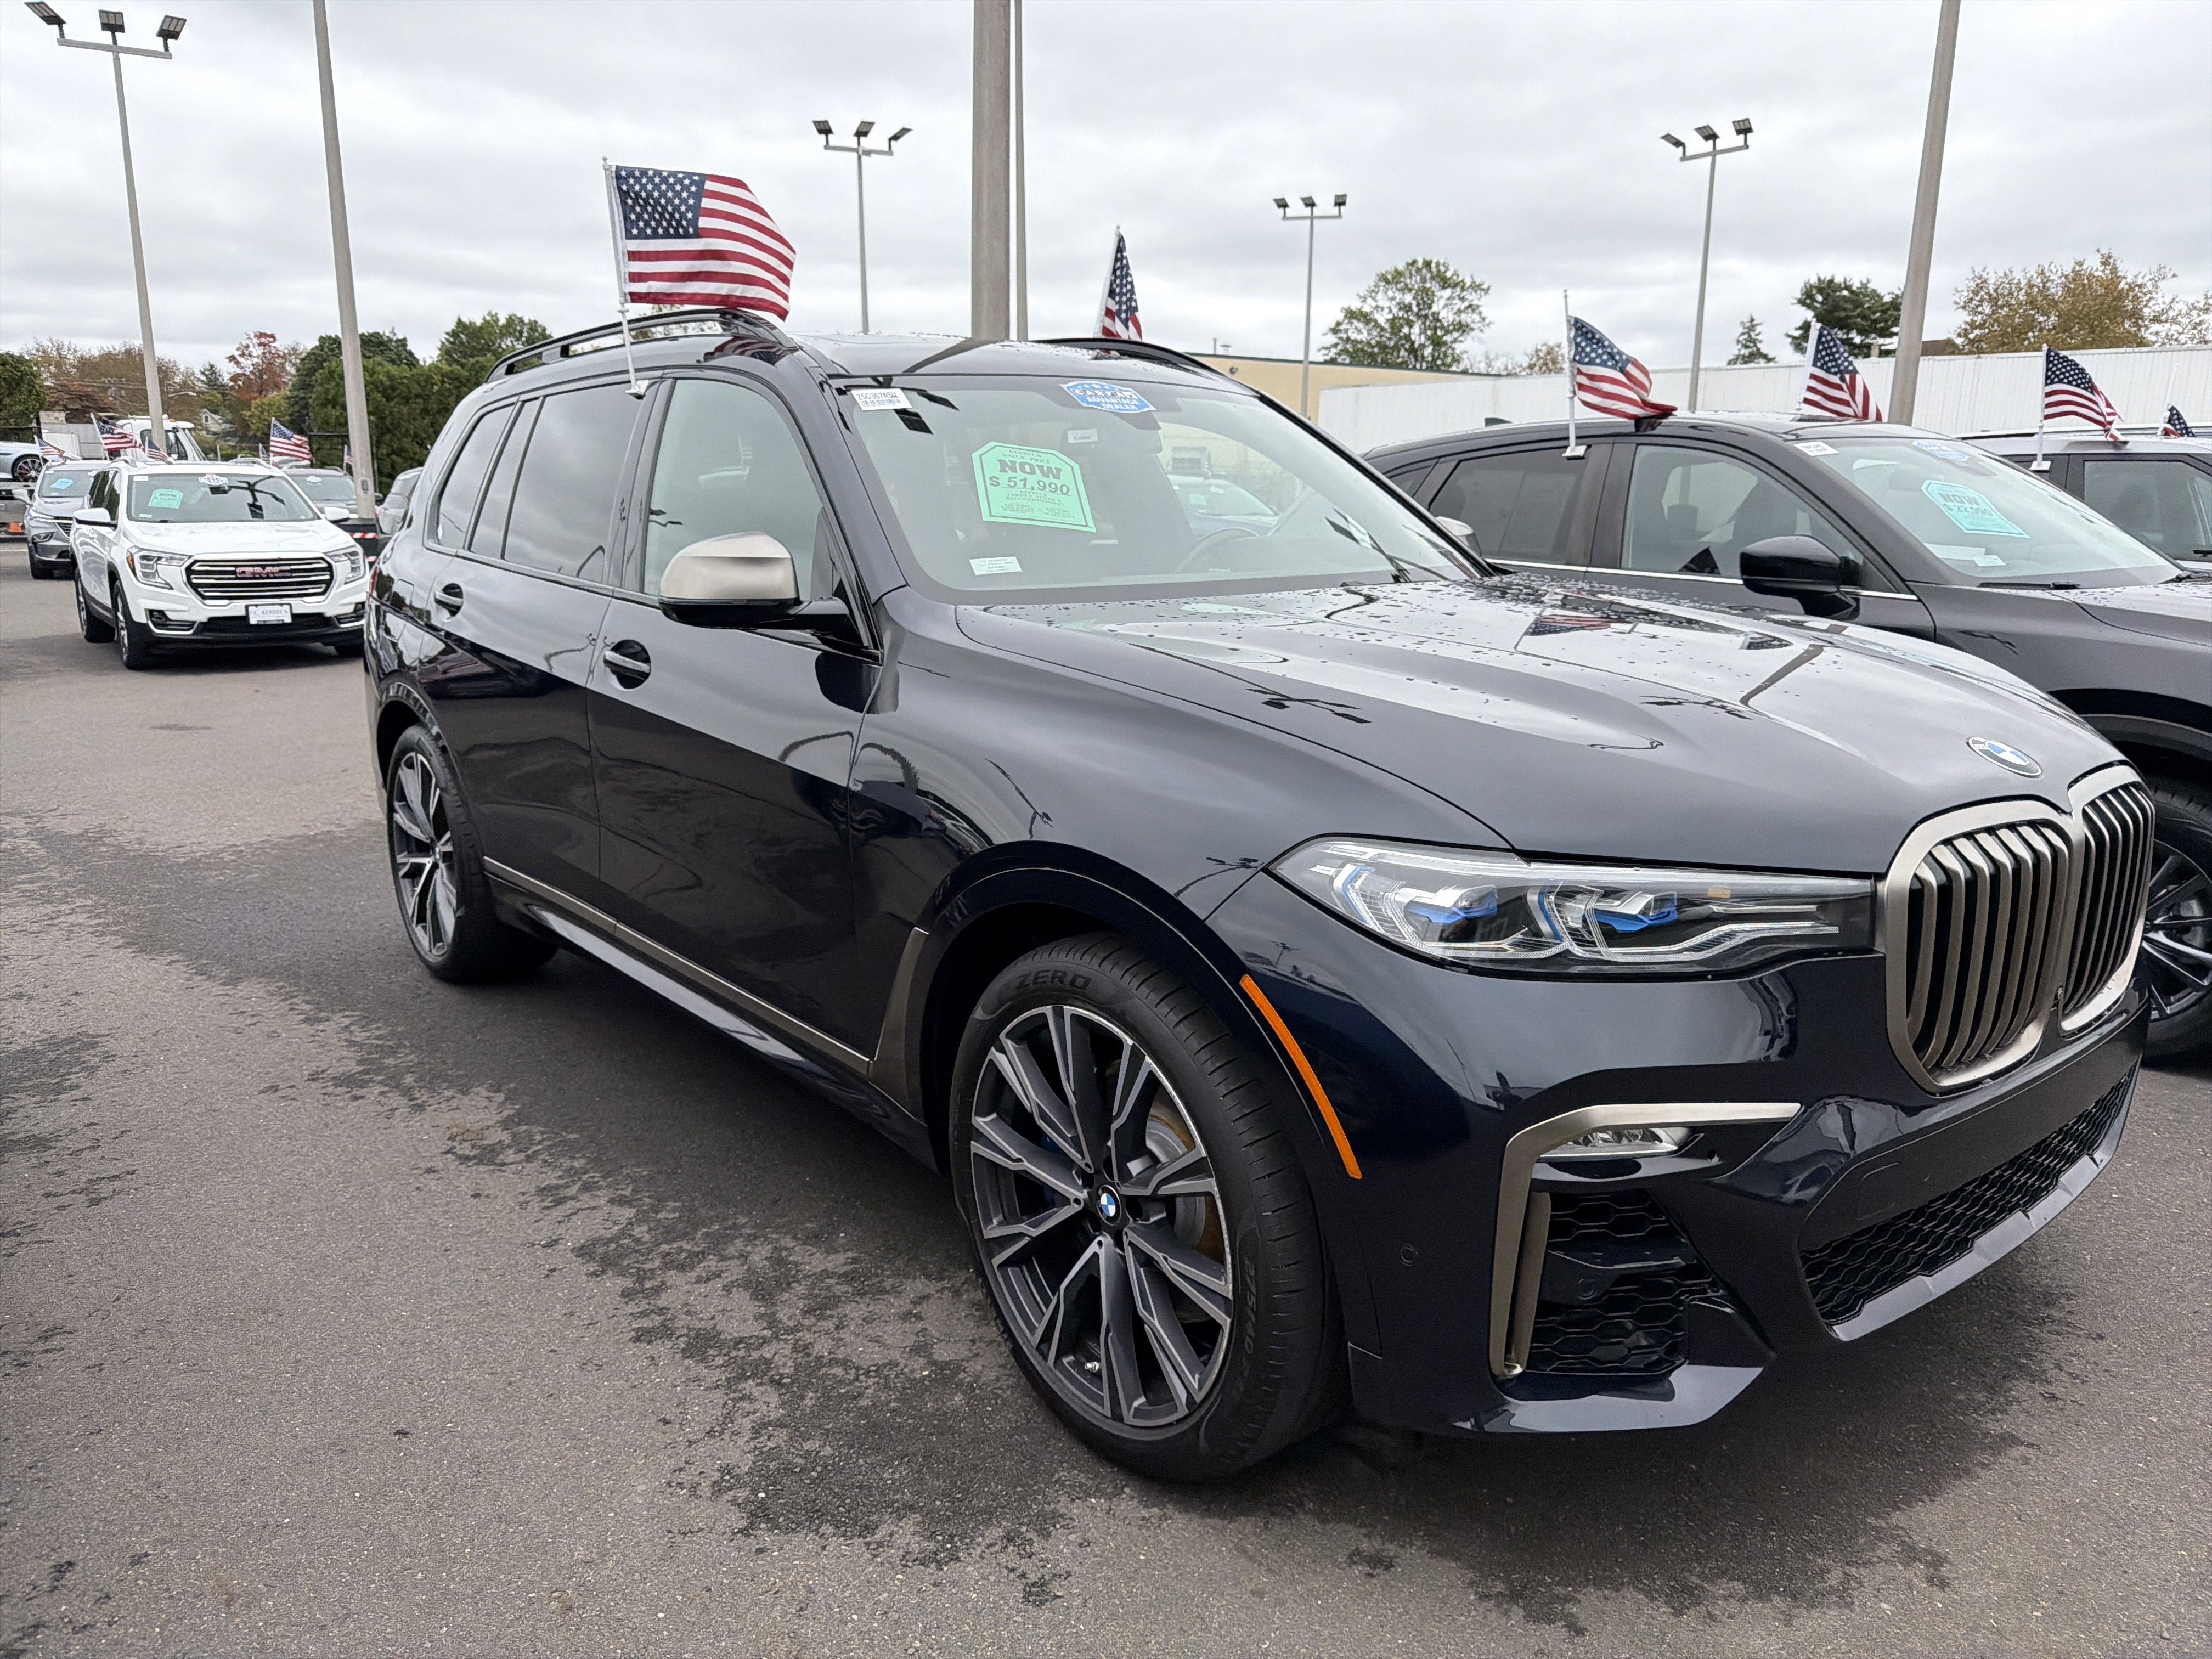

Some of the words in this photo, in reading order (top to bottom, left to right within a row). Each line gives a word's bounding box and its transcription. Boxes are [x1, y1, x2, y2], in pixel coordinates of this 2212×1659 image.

[1086, 397, 1141, 405] ADVANTAGE
[1009, 449, 1042, 458] KERBECK
[998, 459, 1062, 480] NOW
[989, 476, 1001, 487] $
[1007, 477, 1070, 495] 51,990
[1938, 493, 1980, 506] NOW
[236, 566, 291, 578] GMC
[1016, 969, 1092, 990] ZERO
